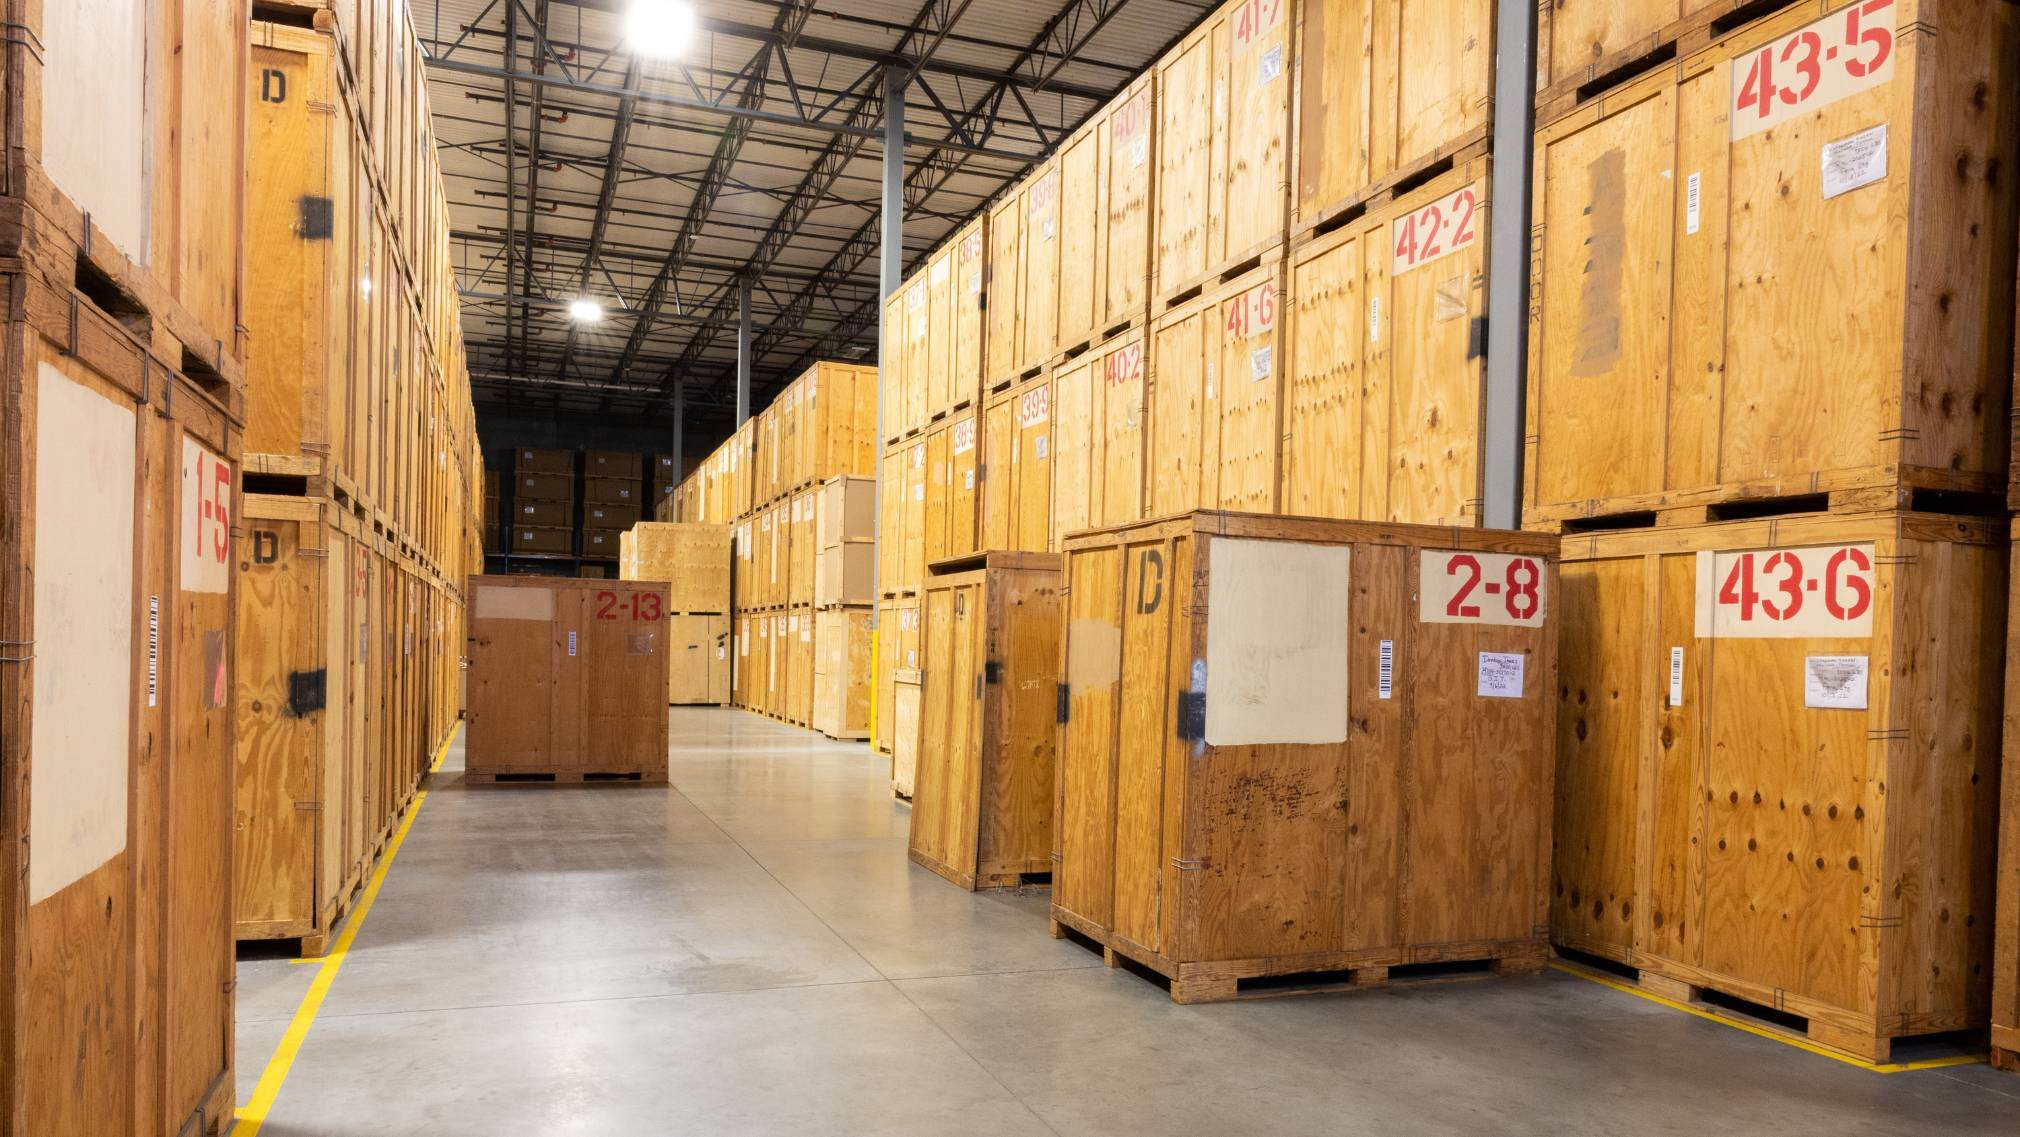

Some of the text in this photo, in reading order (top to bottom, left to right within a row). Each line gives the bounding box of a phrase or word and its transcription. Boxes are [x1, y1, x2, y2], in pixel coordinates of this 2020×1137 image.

[262, 69, 286, 104] D
[1736, 0, 1895, 119] 43-5
[1396, 190, 1475, 265] 42-2
[1227, 283, 1274, 338] 41-6
[1105, 343, 1141, 388] 40-2
[197, 450, 230, 565] 1-5
[253, 530, 279, 564] D
[596, 591, 662, 622] 2-13
[1137, 549, 1164, 614] D
[1446, 554, 1539, 620] 2-8
[1719, 547, 1871, 621] 43-6
